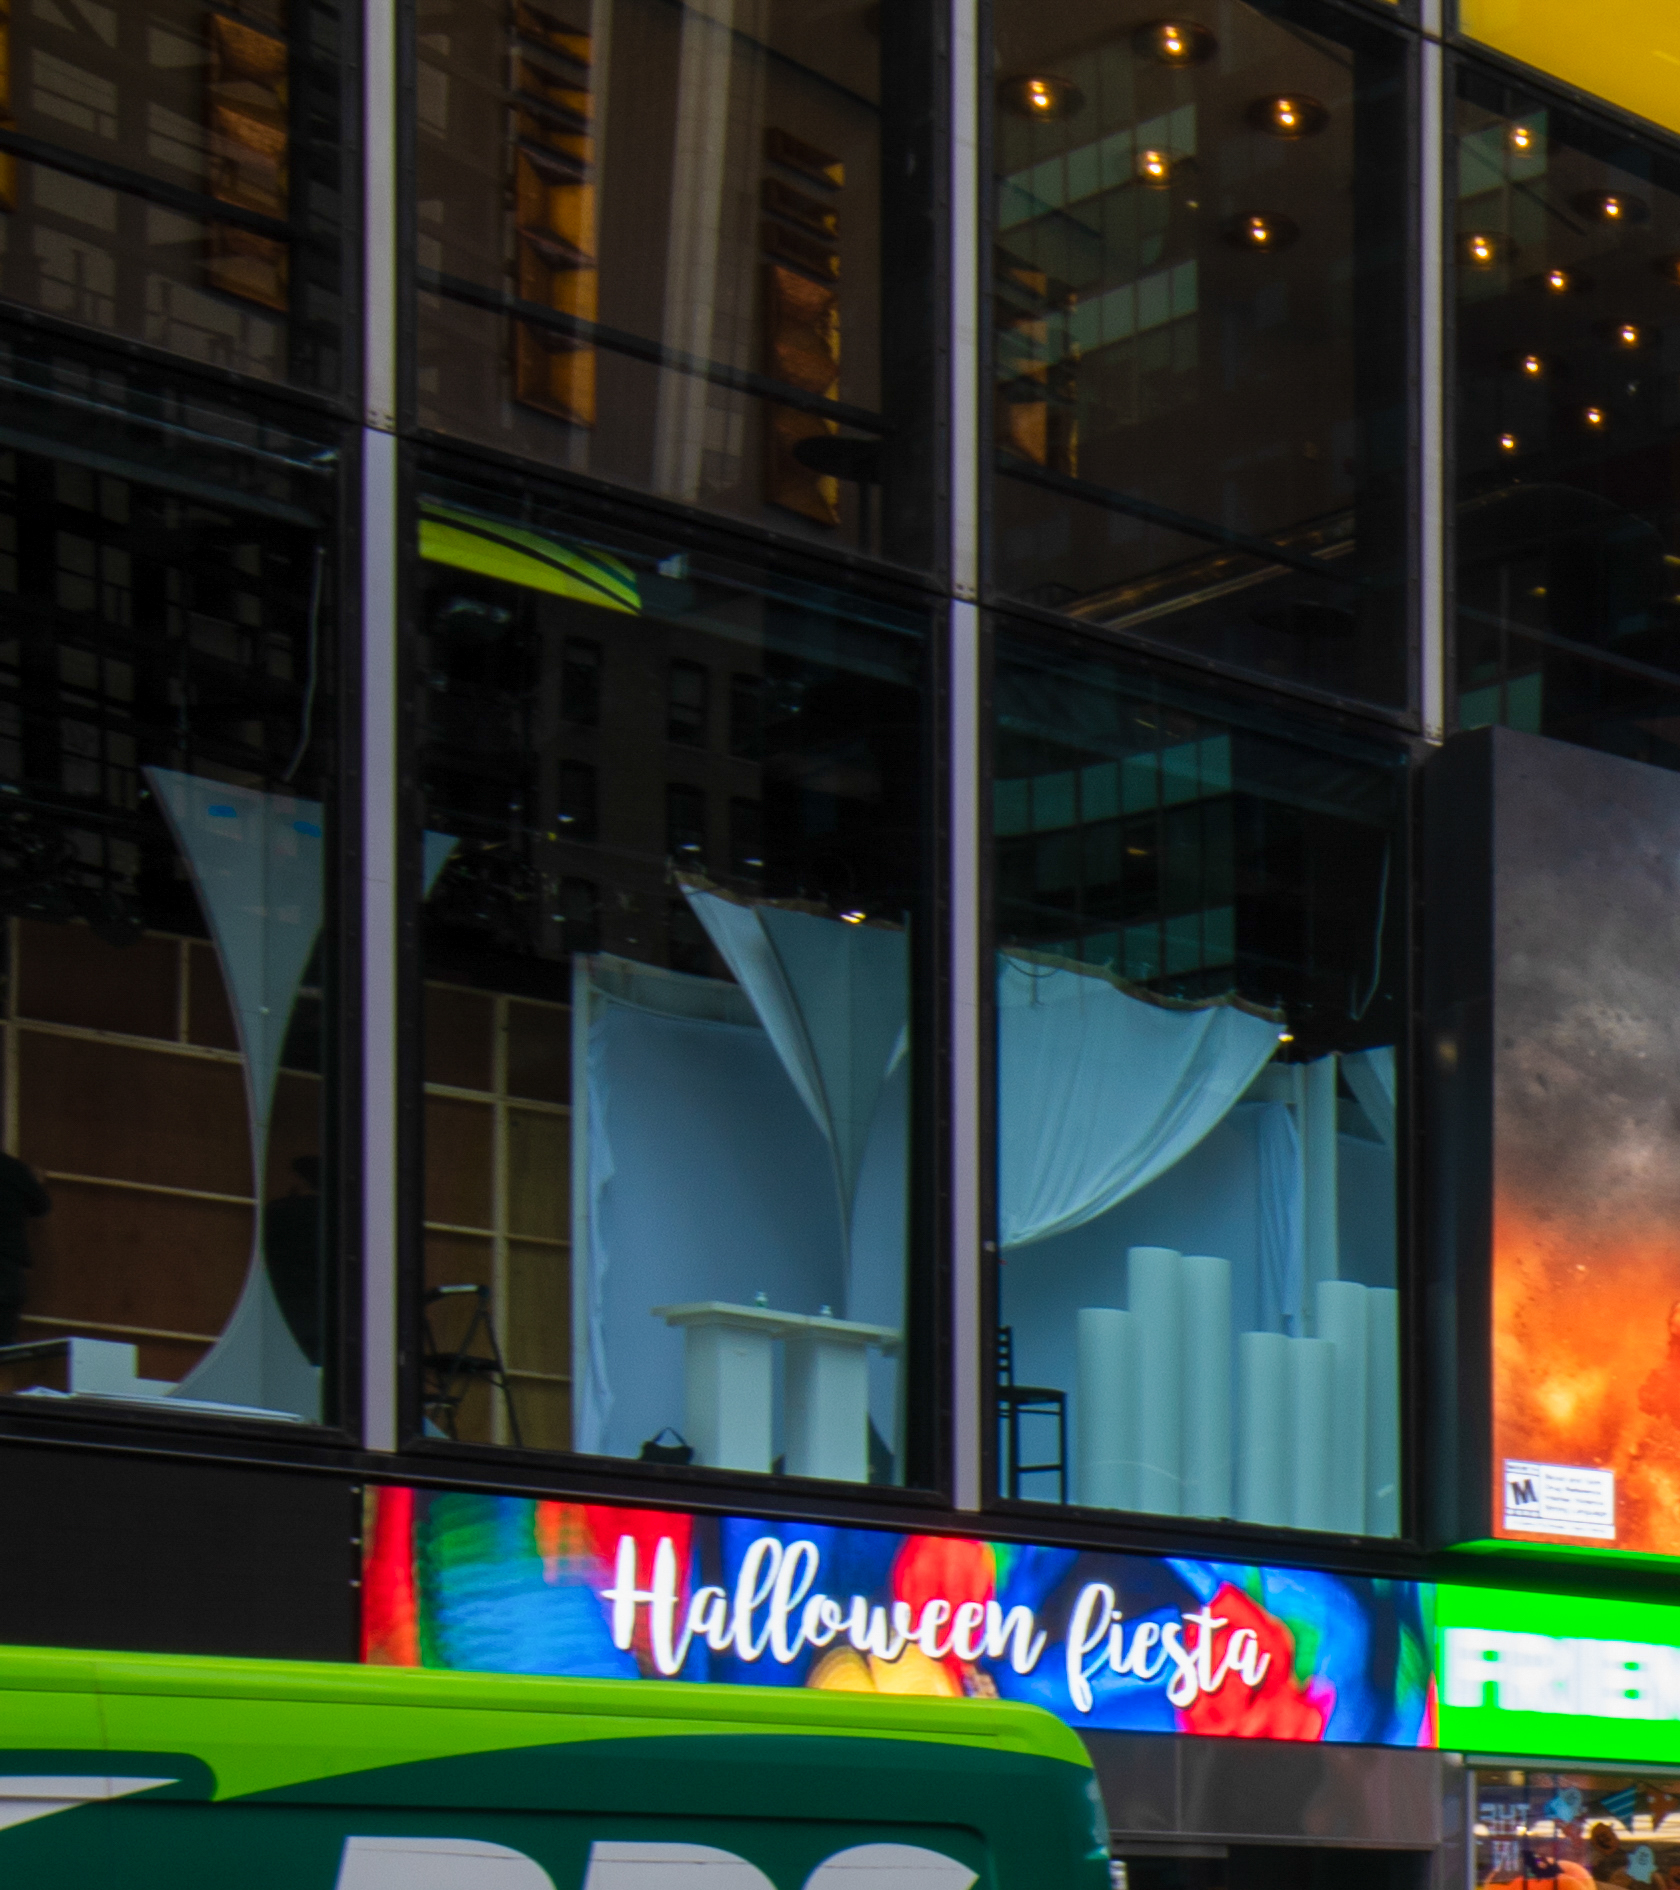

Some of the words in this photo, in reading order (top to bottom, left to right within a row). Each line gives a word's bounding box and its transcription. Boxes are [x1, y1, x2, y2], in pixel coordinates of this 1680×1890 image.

[1509, 1478, 1538, 1506] M
[600, 1534, 1048, 1677] Halloween
[1064, 1582, 1271, 1714] fiesta
